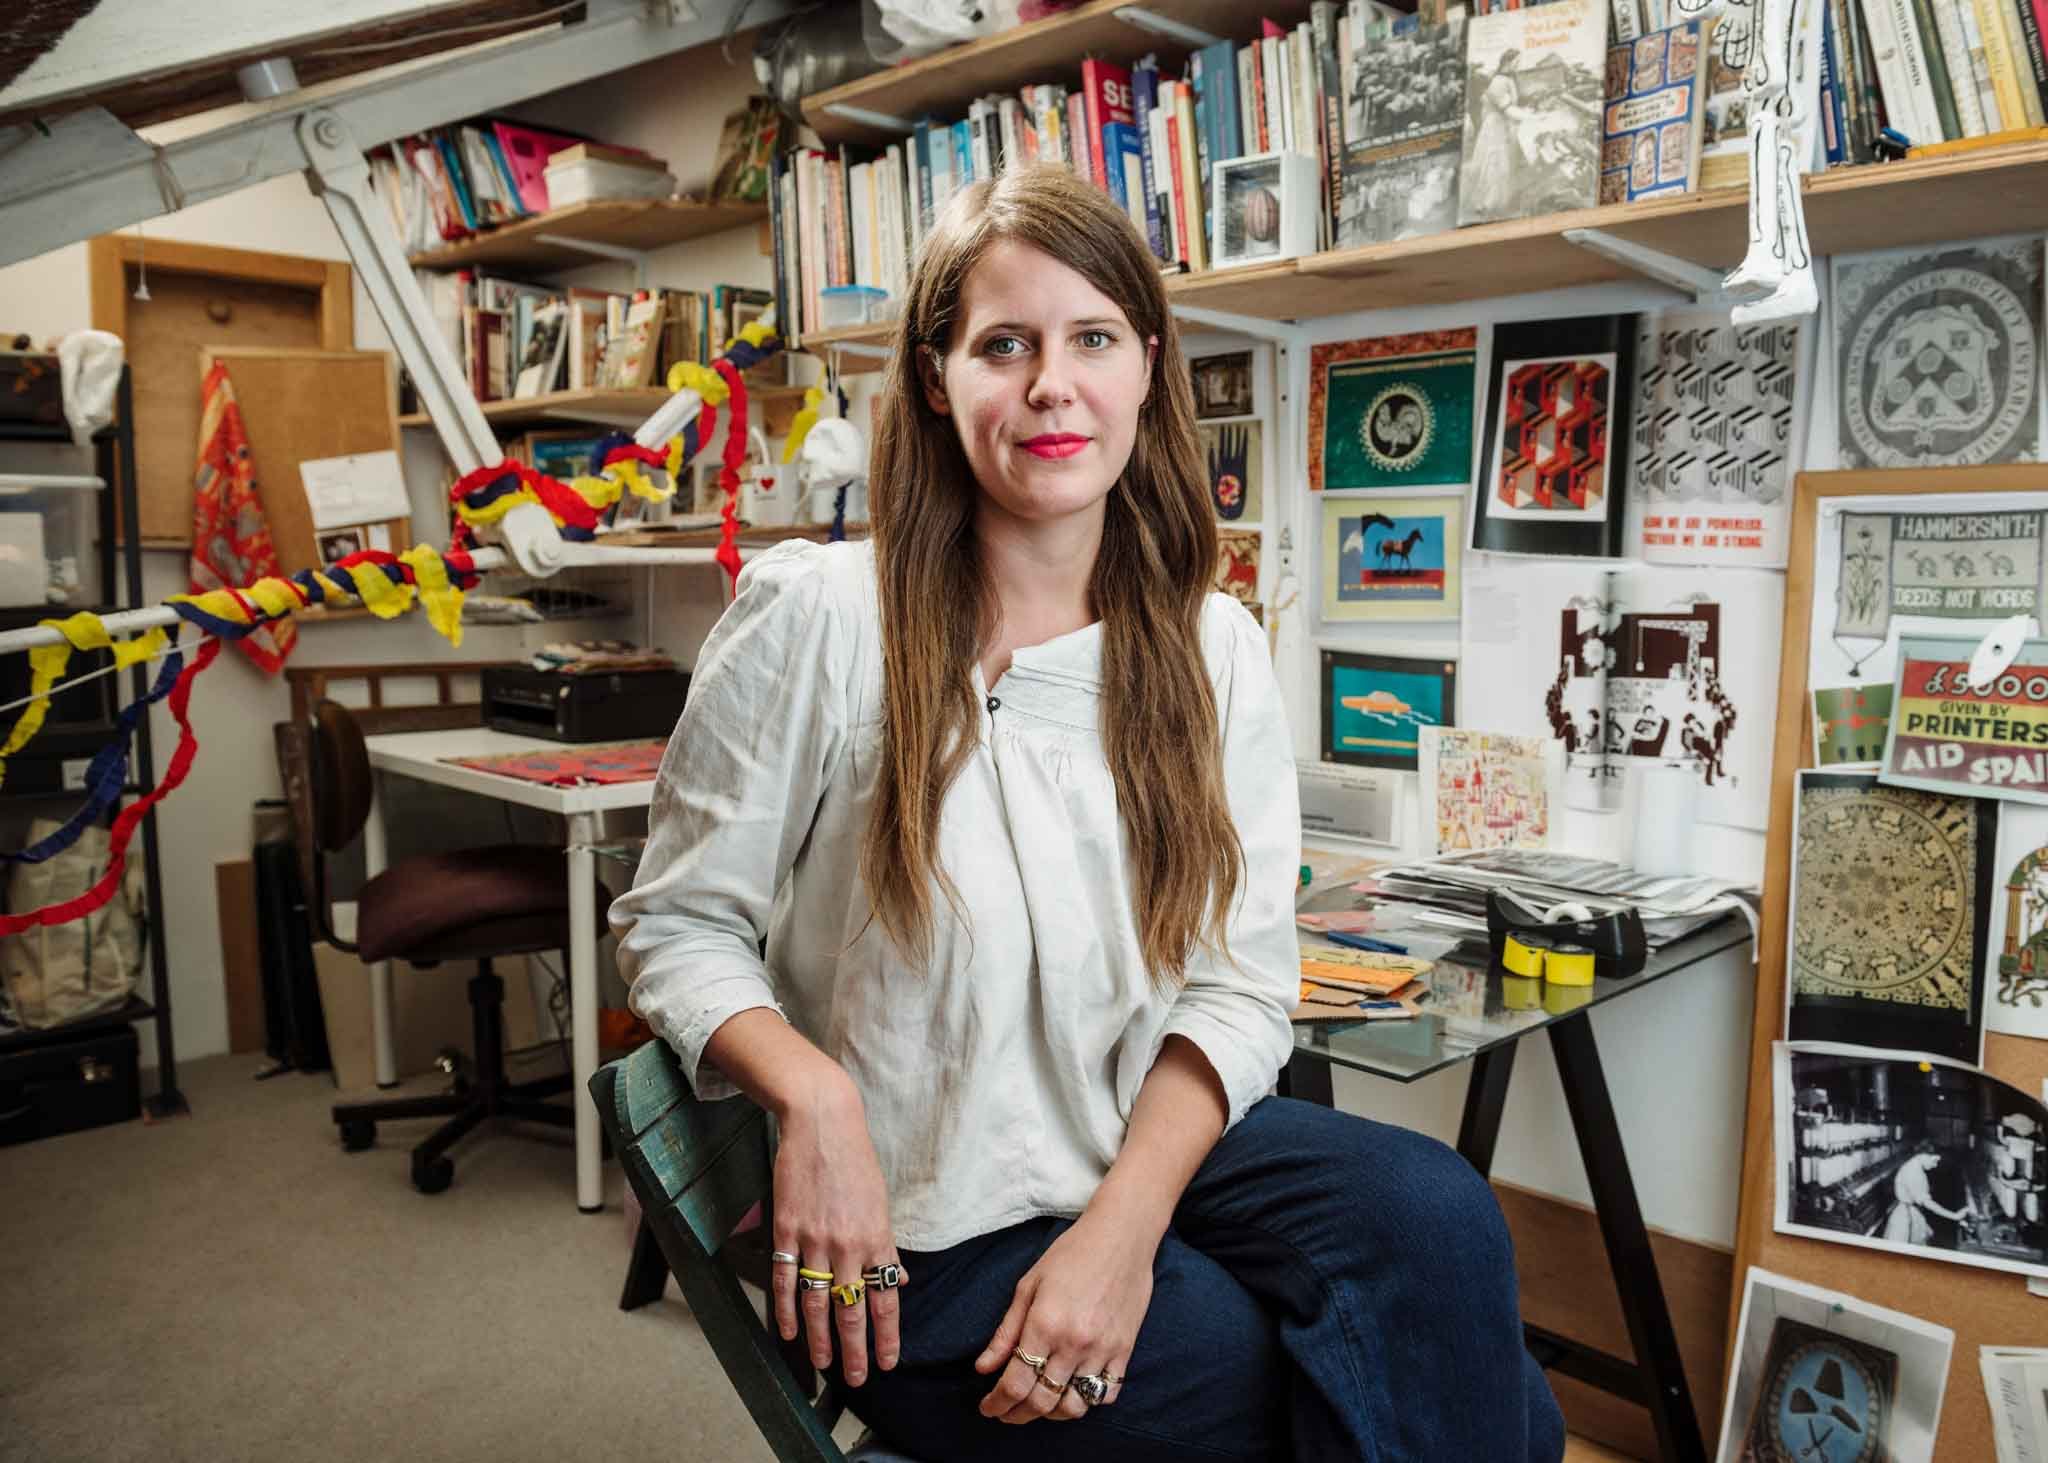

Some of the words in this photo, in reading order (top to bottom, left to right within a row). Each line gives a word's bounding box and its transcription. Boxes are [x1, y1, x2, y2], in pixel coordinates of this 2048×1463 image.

[1900, 515, 2039, 539] HAMMERSMITH
[1895, 587, 1944, 608] DEEDS
[1945, 589, 1977, 609] NOT
[1980, 589, 2035, 609] WORDS
[1940, 701, 1981, 715] GIVEN
[1989, 704, 2010, 717] BY
[1907, 713, 2048, 743] PRINTERS
[1901, 743, 1964, 771] AID
[1968, 753, 2048, 784] SPAI
